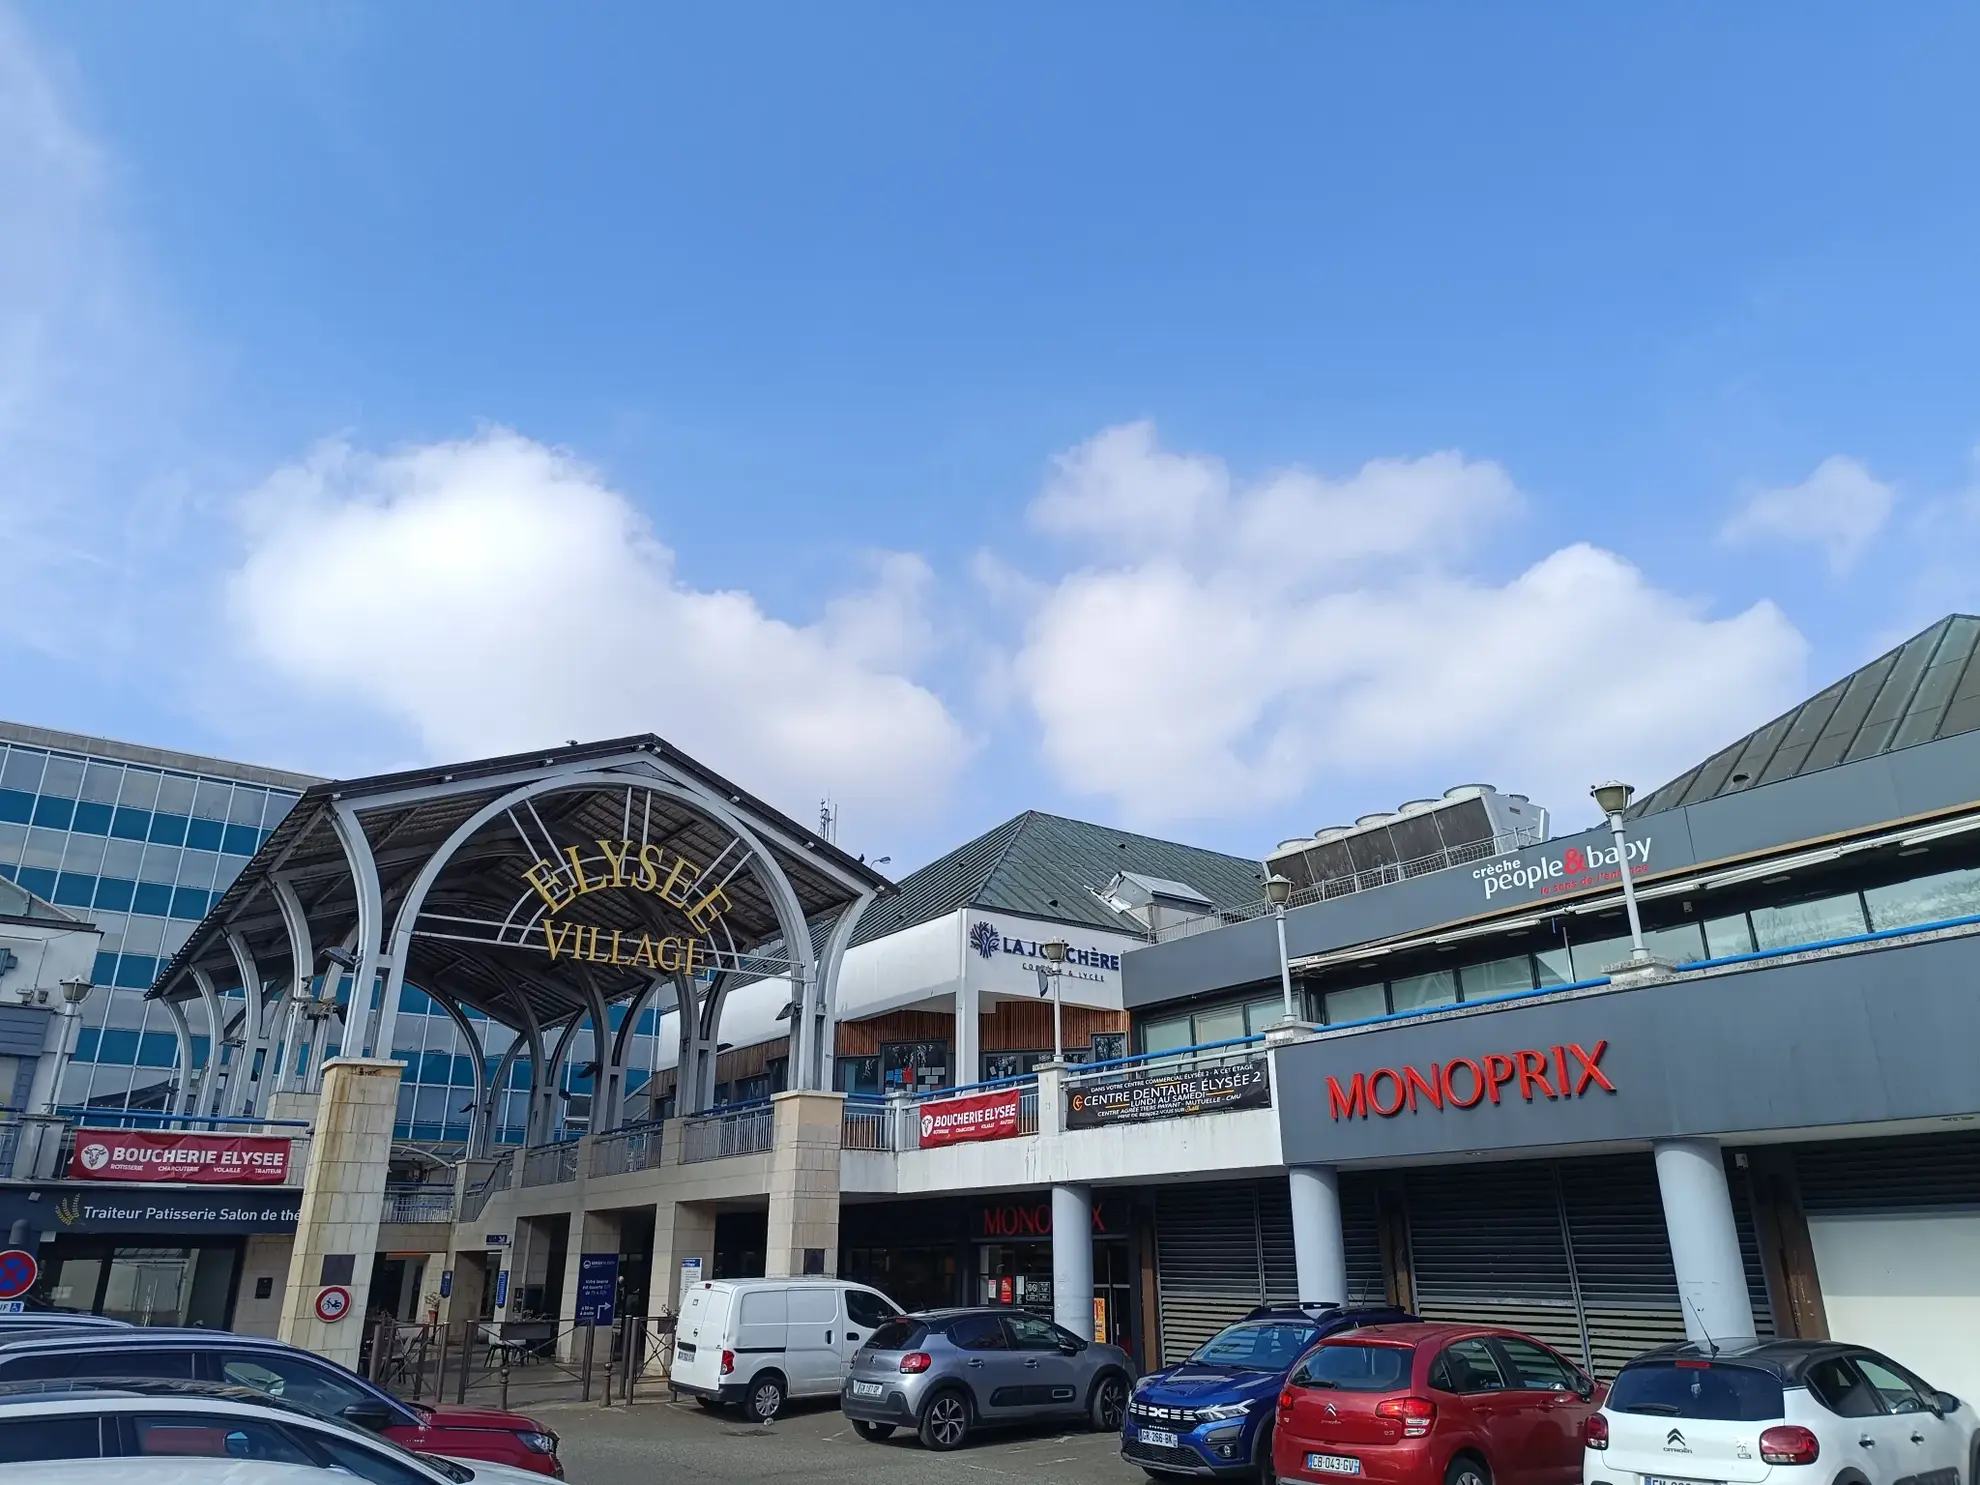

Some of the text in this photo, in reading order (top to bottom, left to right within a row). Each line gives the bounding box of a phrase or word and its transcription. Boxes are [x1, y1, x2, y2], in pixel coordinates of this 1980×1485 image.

[1472, 858, 1521, 879] crèche
[521, 840, 732, 935] ELYSEE
[1541, 886, 1550, 895] le
[1553, 881, 1577, 892] sens
[1581, 875, 1593, 885] de
[541, 919, 706, 976] VILLAGE
[1003, 937, 1025, 955] LA
[1084, 1071, 1262, 1106] CENTRE DENTAIRE ÉLYSÉE 2
[1091, 1085, 1105, 1093] DANS
[1106, 1082, 1123, 1091] VOTRE
[1124, 1080, 1144, 1089] CENTRE
[1145, 1075, 1183, 1085] COMMERCIAL
[1220, 1066, 1231, 1075] CET
[1325, 1040, 1617, 1120] MONOPRIX
[1097, 1109, 1119, 1118] CENTRE
[1140, 1104, 1157, 1113] TIERS
[1157, 1101, 1181, 1111] PAYANT
[1186, 1097, 1221, 1107] MUTUELLE
[1225, 1093, 1242, 1101] CMU
[1130, 1091, 1206, 1108] LUNDI AU SAMEDI
[934, 1103, 1016, 1127] BOUCHERIE ELYSEE
[111, 1147, 284, 1166] BOUCHERIE ELYSEE
[110, 1163, 143, 1171] ROTISSERIE
[158, 1165, 200, 1173] CHARCUTERIE
[84, 1206, 301, 1221] Traiteur Patisserie Salon de thé
[984, 1202, 1106, 1235] MONOX
[1142, 1430, 1173, 1444] GR-266-BK
[1312, 1455, 1354, 1471] CB-043-GV
